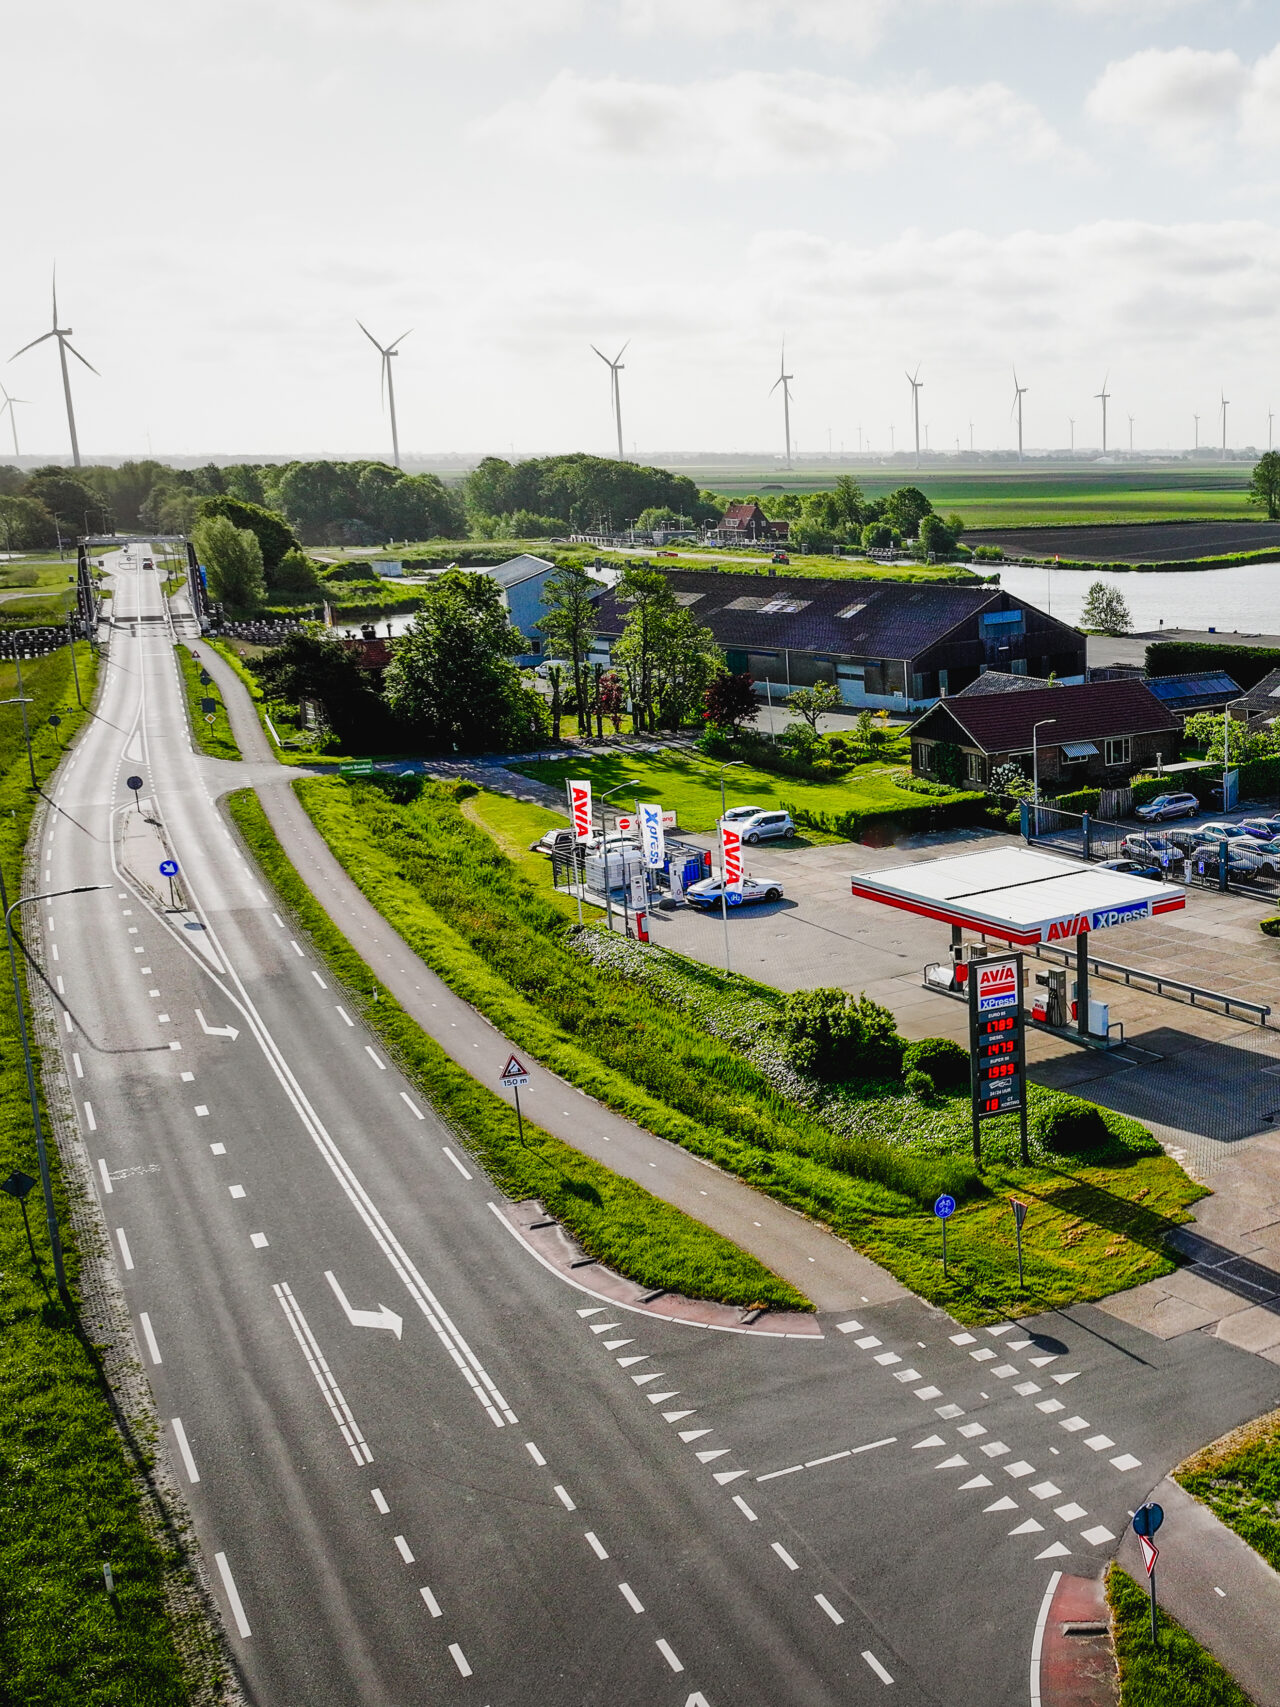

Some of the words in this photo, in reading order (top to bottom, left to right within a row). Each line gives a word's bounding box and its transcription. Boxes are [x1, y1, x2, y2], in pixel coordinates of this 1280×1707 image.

[1096, 908, 1148, 928] XPress
[982, 997, 1014, 1010] XPress
[503, 1079, 518, 1087] 150
[986, 1098, 999, 1111] 18
